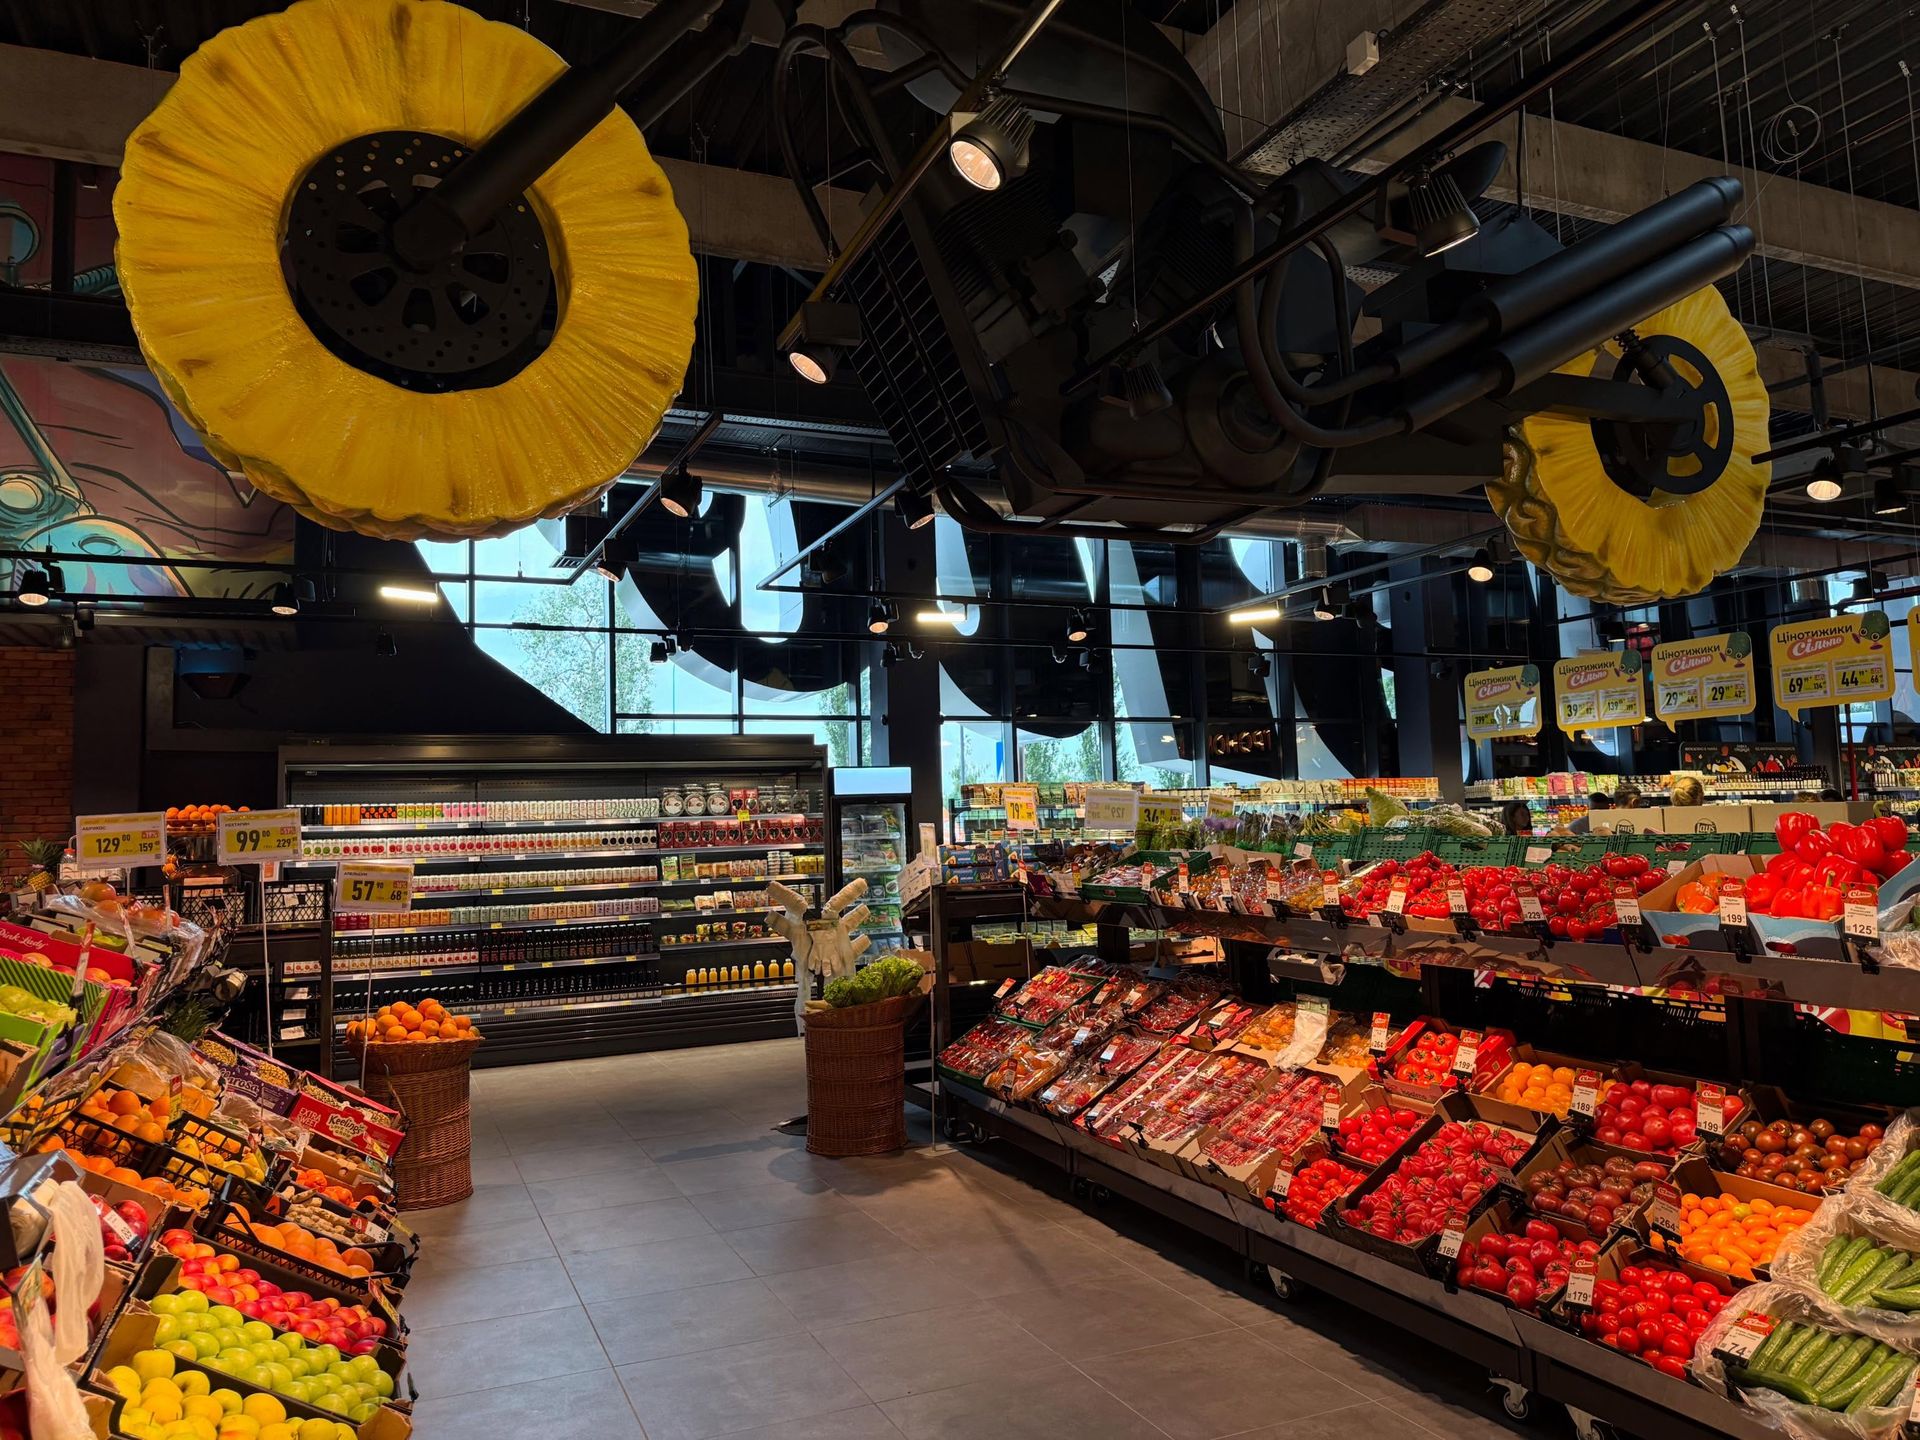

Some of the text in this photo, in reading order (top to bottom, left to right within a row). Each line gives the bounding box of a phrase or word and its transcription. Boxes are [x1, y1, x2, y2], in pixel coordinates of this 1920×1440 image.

[1776, 625, 1853, 644] Цінотижики
[1657, 645, 1720, 661] Цінотижики
[1792, 637, 1842, 656] Сільпо
[1558, 661, 1615, 676] Цінотижики
[1669, 655, 1711, 673] Сільпо
[1468, 675, 1517, 688] Цінотижики
[1570, 671, 1607, 687] Сільпо
[1788, 677, 1803, 693] 69
[1841, 671, 1858, 687] 44
[1478, 683, 1510, 698] Сільпо
[1711, 686, 1725, 701] 29
[1665, 692, 1678, 706] 29
[1567, 704, 1578, 717] 39
[1010, 802, 1019, 819] 79
[96, 837, 120, 853] 129
[139, 842, 153, 852] 159
[236, 830, 260, 852] 99
[276, 838, 291, 848] 229
[352, 880, 374, 901] 57
[390, 890, 402, 900] 68
[1623, 915, 1637, 923] 199
[1727, 913, 1742, 923] 199
[1852, 923, 1872, 935] 125
[21, 936, 46, 950] Lady
[1459, 1061, 1470, 1070] 199
[300, 1107, 322, 1122] EXTRA
[1576, 1102, 1590, 1112] 189
[328, 1115, 362, 1135] Keelings
[1703, 1120, 1719, 1132] 199
[1660, 1217, 1676, 1231] 264
[1573, 1291, 1588, 1302] 179
[1728, 1342, 1747, 1357] 74
